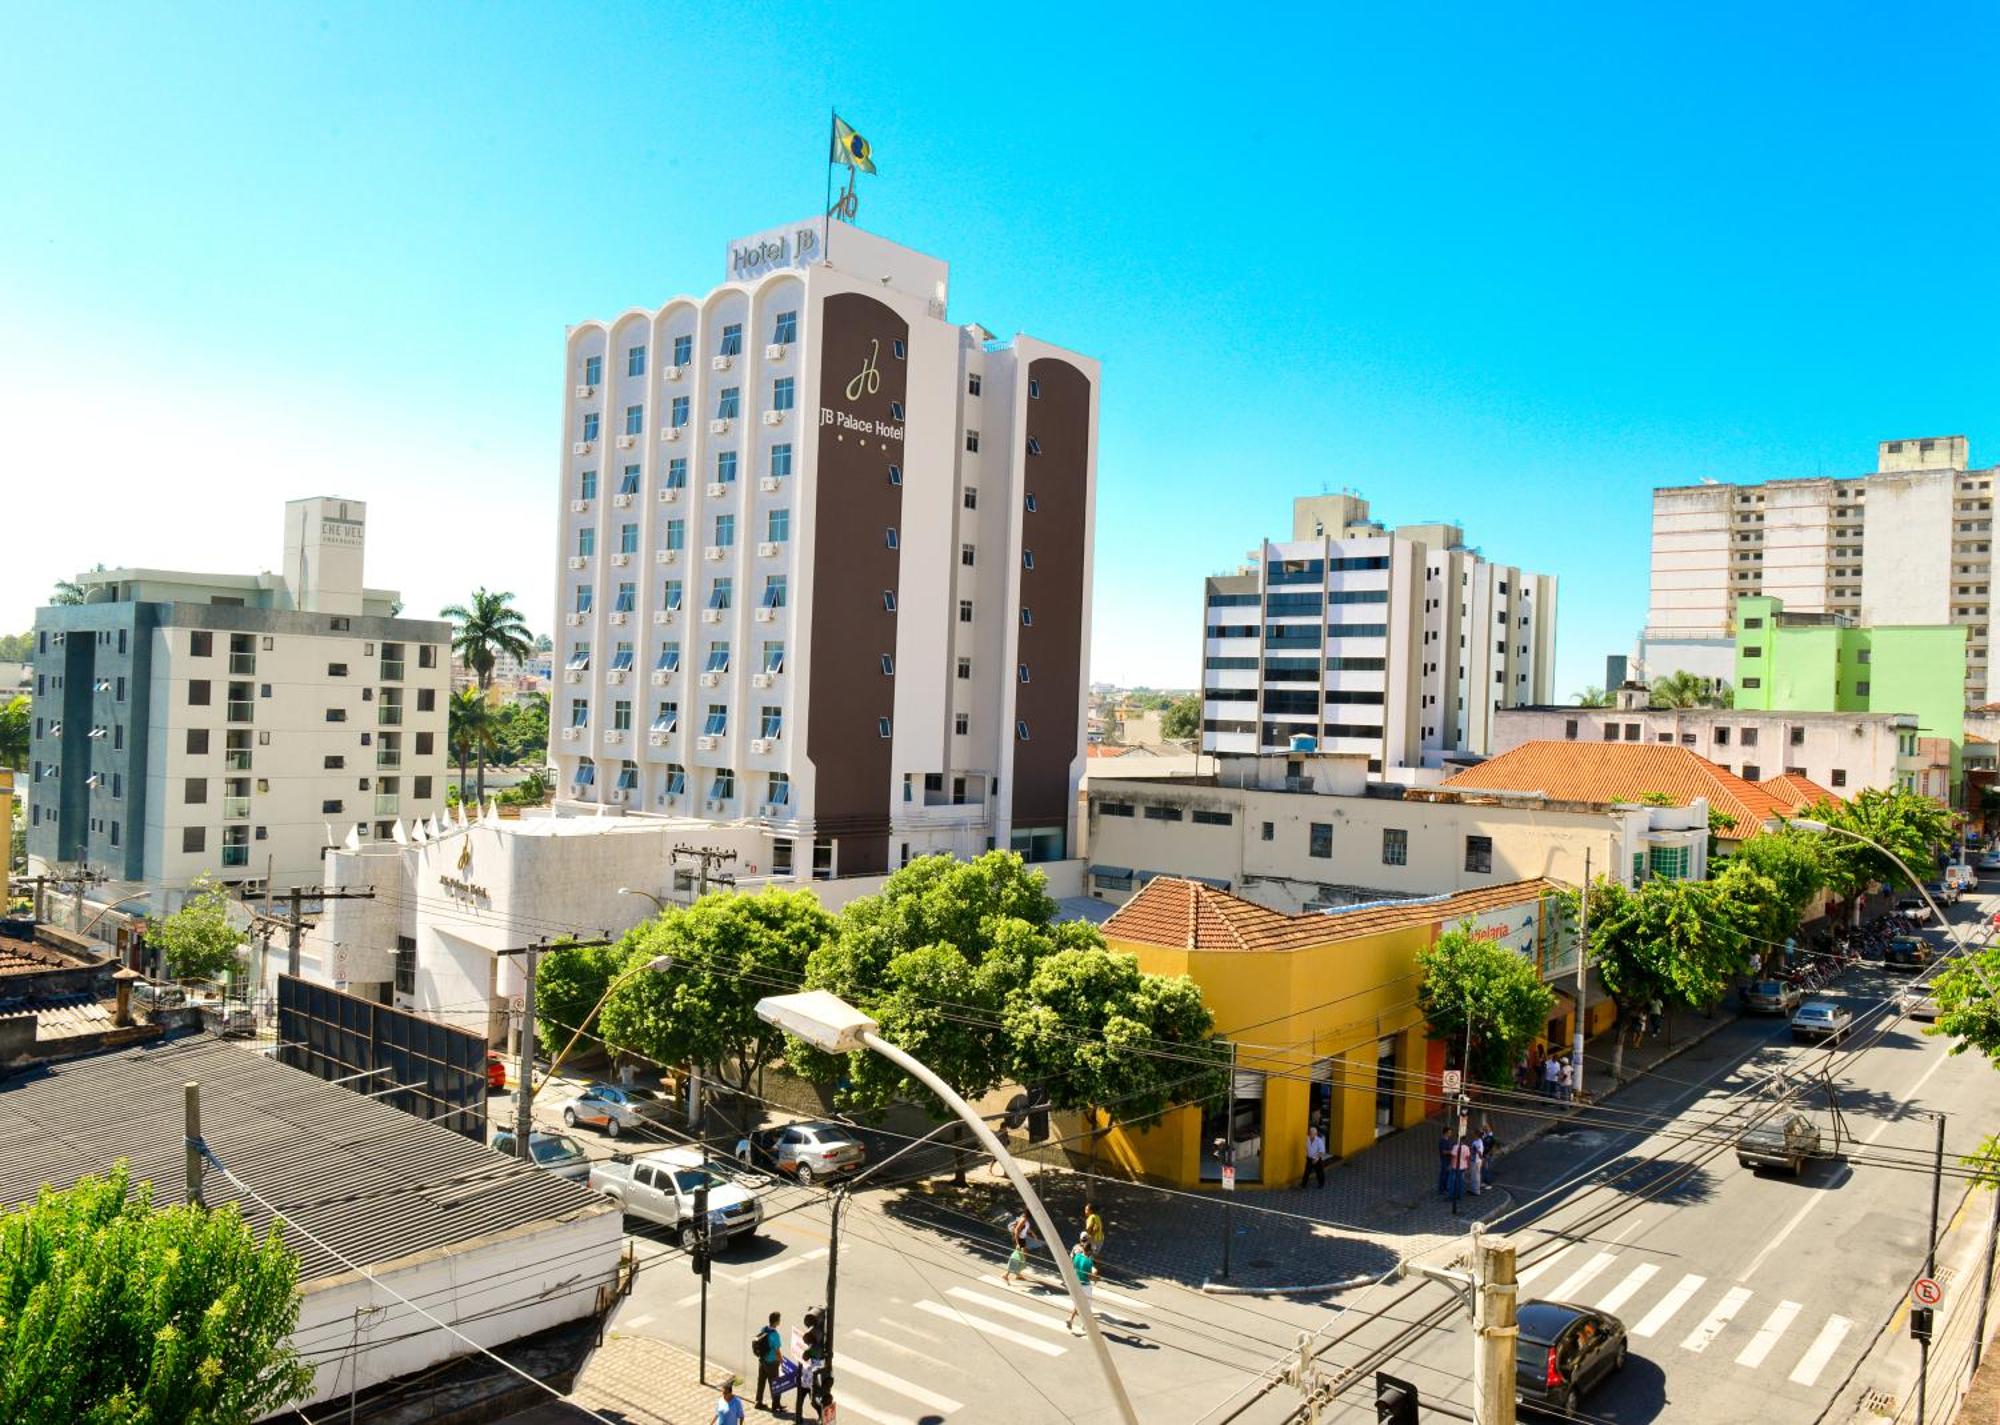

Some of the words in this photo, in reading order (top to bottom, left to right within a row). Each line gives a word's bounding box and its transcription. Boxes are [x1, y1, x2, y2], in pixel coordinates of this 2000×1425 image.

[733, 236, 784, 271] Hotel
[793, 229, 814, 259] JB
[820, 408, 834, 426] JB
[836, 411, 873, 433] Palace
[875, 420, 904, 441] Hotel
